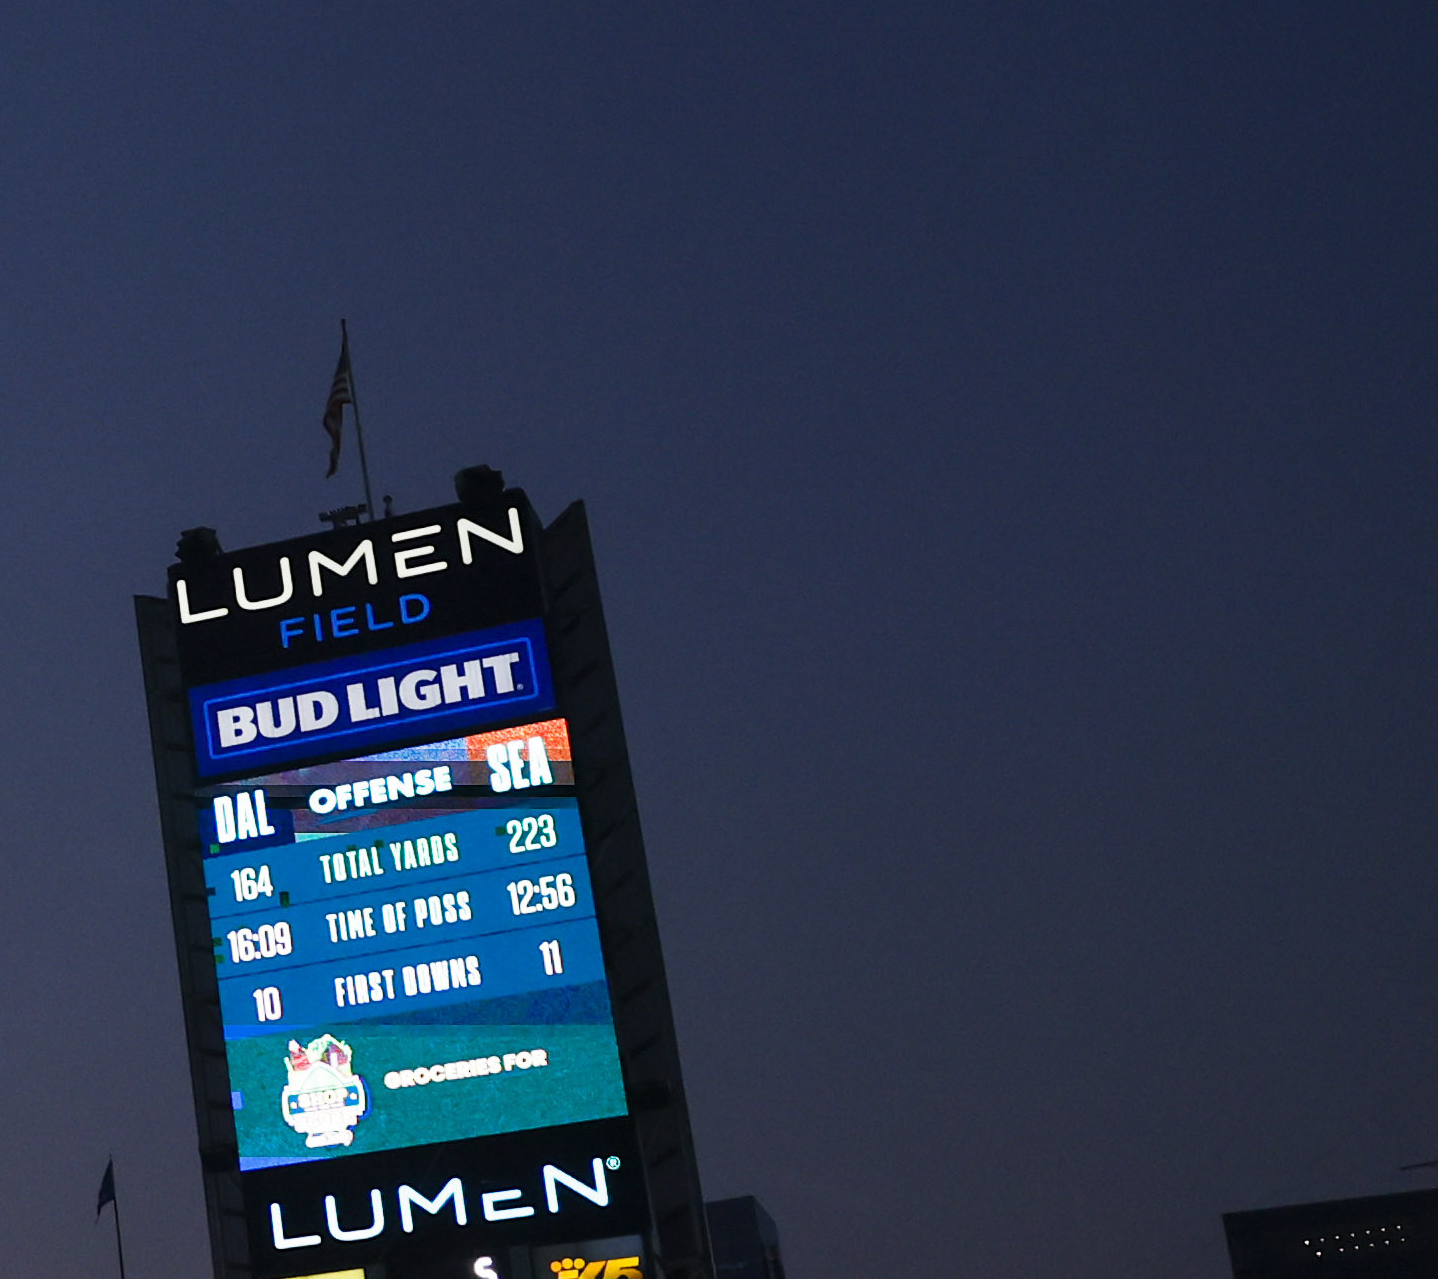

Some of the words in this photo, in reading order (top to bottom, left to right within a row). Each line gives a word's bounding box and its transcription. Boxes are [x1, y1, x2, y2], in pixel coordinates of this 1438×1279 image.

[176, 507, 524, 624] LUMEN
[280, 594, 431, 648] FIELD
[217, 690, 339, 748] BUD
[346, 652, 520, 723] LIGHT
[309, 765, 453, 815] OFFENSE
[486, 736, 554, 793] SEA
[214, 789, 275, 844] DAL
[231, 865, 274, 902] 164
[320, 845, 384, 884] TOTAL
[389, 832, 459, 871] YARDS
[506, 813, 557, 854] 223
[227, 921, 293, 963] 16:09
[326, 907, 376, 943] TIME
[382, 902, 406, 934] OF
[413, 891, 472, 929] POSS
[507, 873, 576, 915] 12:56
[253, 986, 283, 1022] 10
[335, 968, 395, 1007] FIRST
[402, 956, 482, 997] DOWNS
[538, 939, 563, 976] 11
[384, 1054, 502, 1090] GROCERIES
[503, 1048, 549, 1071] FOR
[270, 1157, 609, 1250] LUMEN
